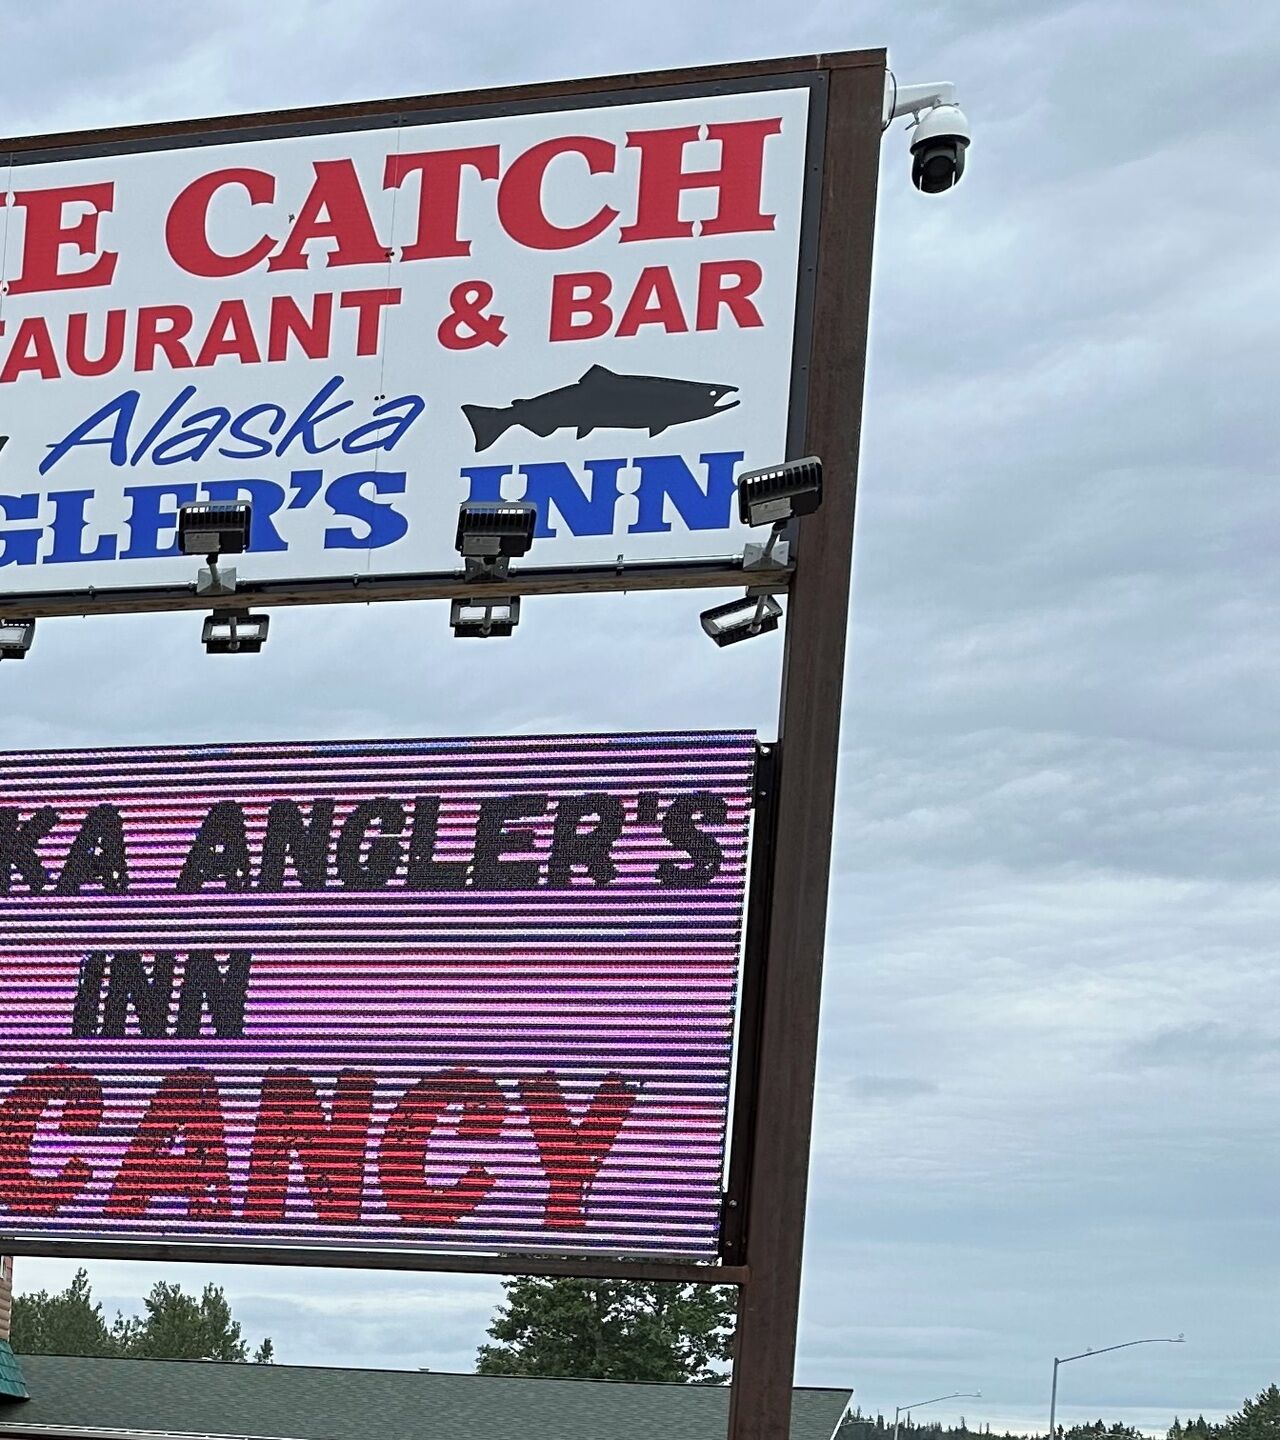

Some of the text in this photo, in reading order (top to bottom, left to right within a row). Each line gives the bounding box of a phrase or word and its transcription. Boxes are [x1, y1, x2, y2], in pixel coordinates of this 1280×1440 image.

[165, 117, 783, 279] CATCH
[438, 280, 507, 351] &
[548, 260, 764, 343] BAR
[40, 375, 425, 476] Alaska
[176, 792, 730, 896] ANGLER'S
[71, 948, 253, 1040] INN
